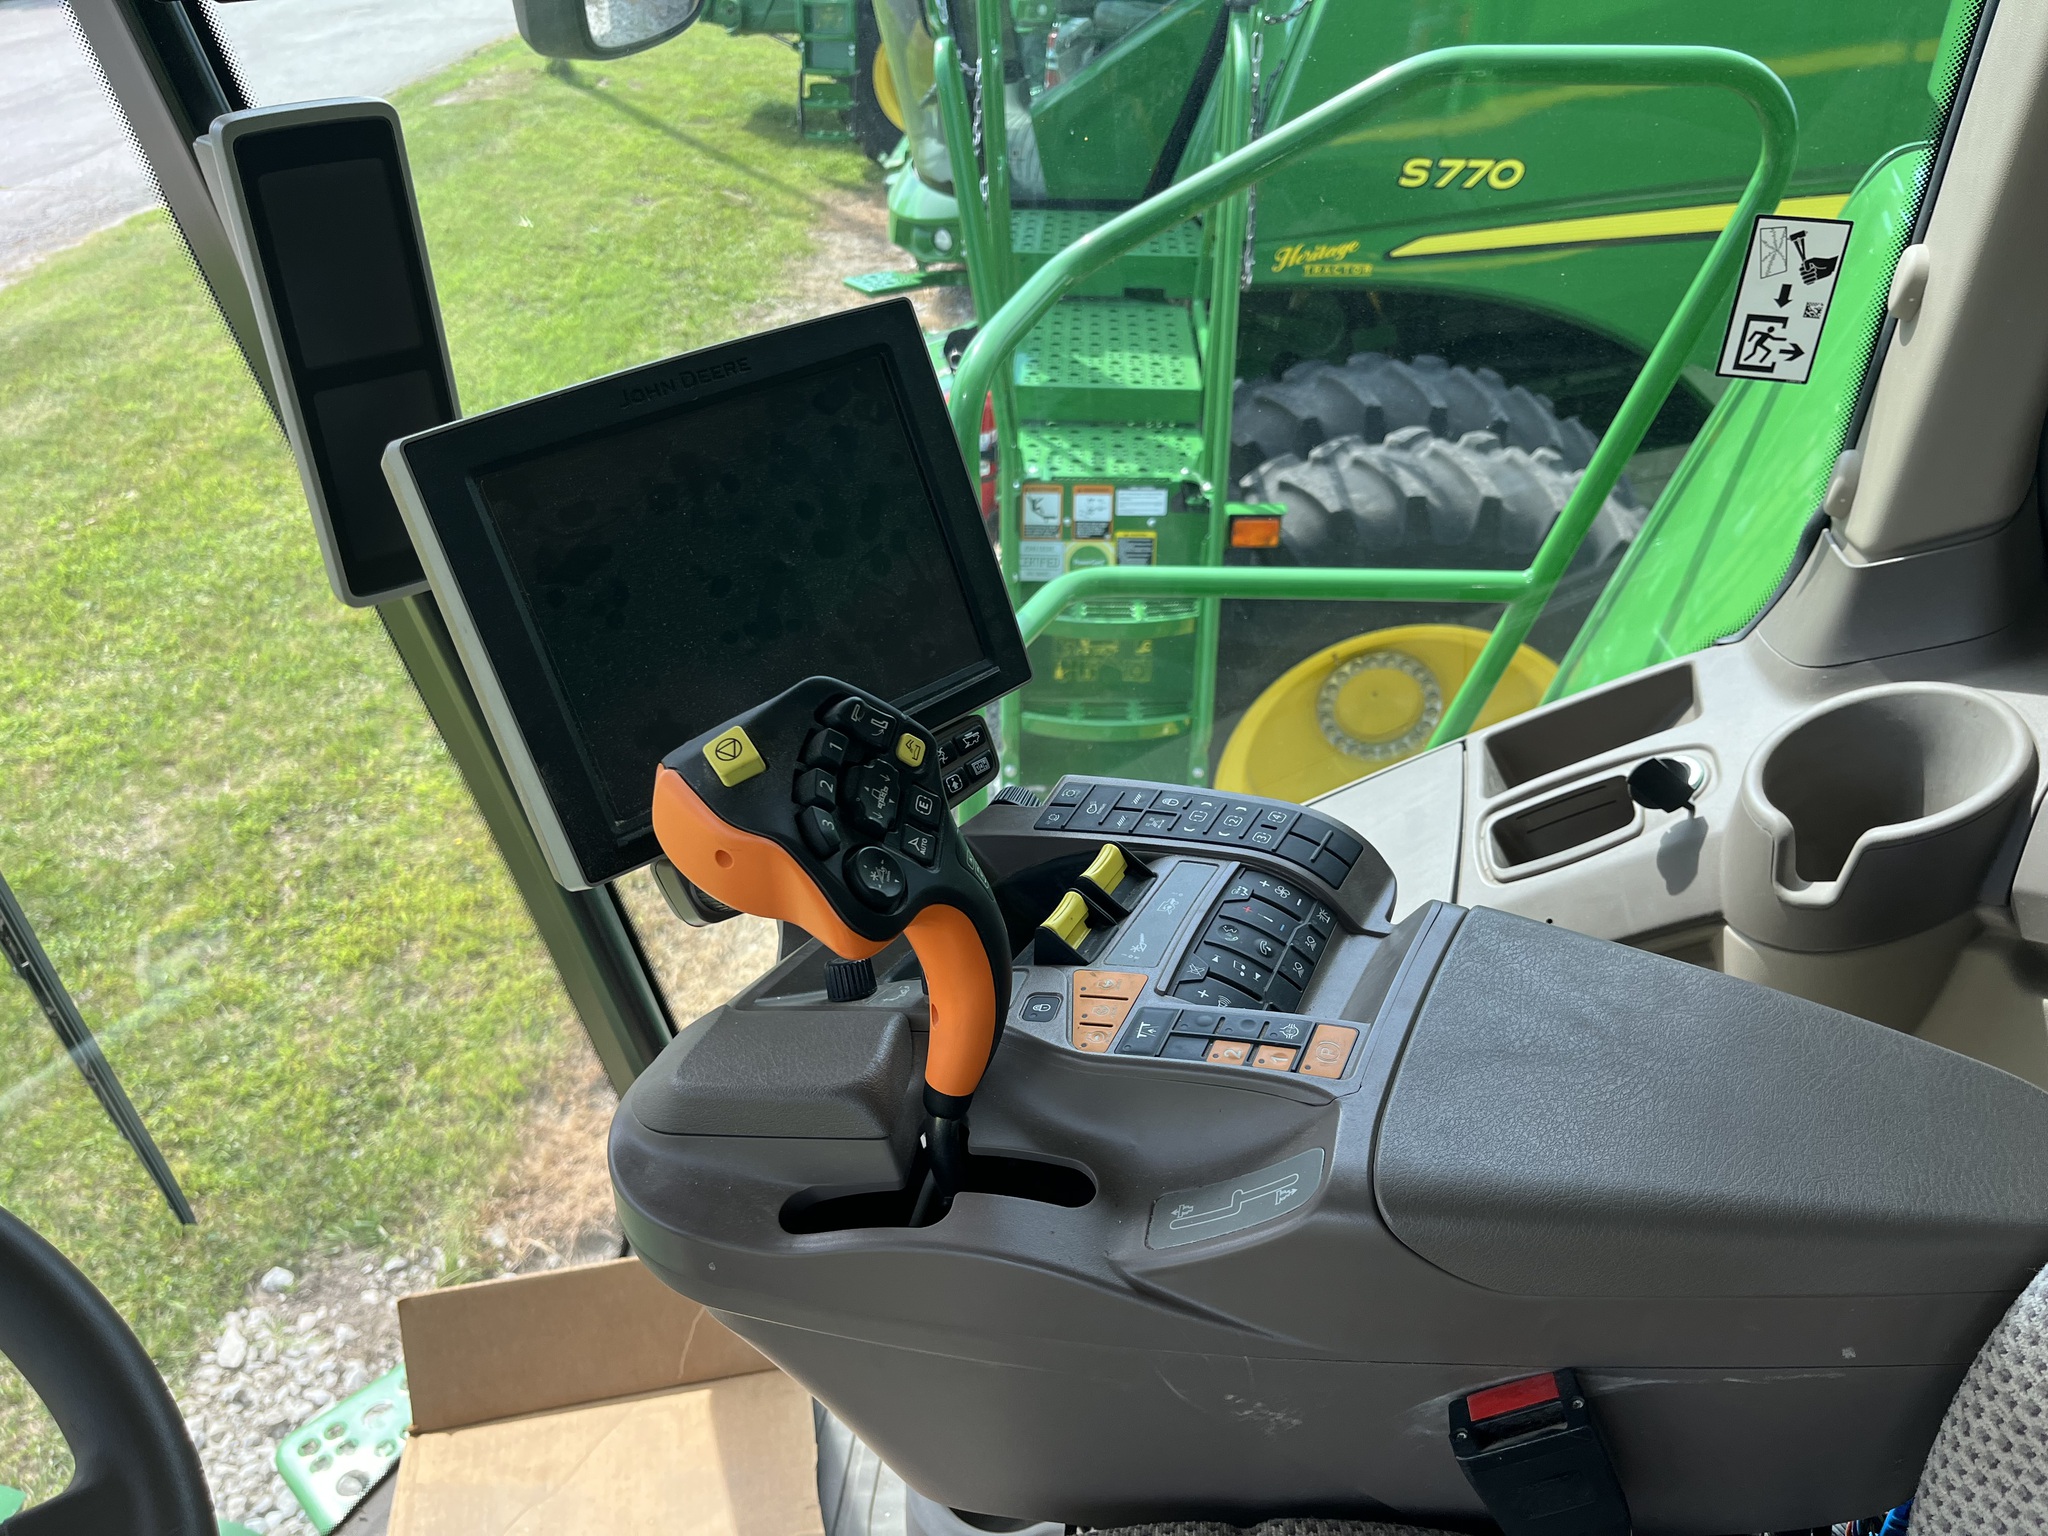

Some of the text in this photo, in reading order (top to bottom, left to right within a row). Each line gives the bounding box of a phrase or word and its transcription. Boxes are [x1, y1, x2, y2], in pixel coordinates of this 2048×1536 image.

[1397, 157, 1526, 190] S770
[1271, 240, 1360, 273] Heritage
[1303, 263, 1373, 277] TRACTOR
[620, 357, 752, 409] JOHN DEERE
[829, 741, 843, 751] 1
[819, 779, 834, 793] 2
[918, 799, 929, 810] E
[822, 818, 835, 831] 3
[920, 837, 929, 856] AUTO
[1223, 1048, 1243, 1059] 2
[1271, 1056, 1289, 1064] 1
